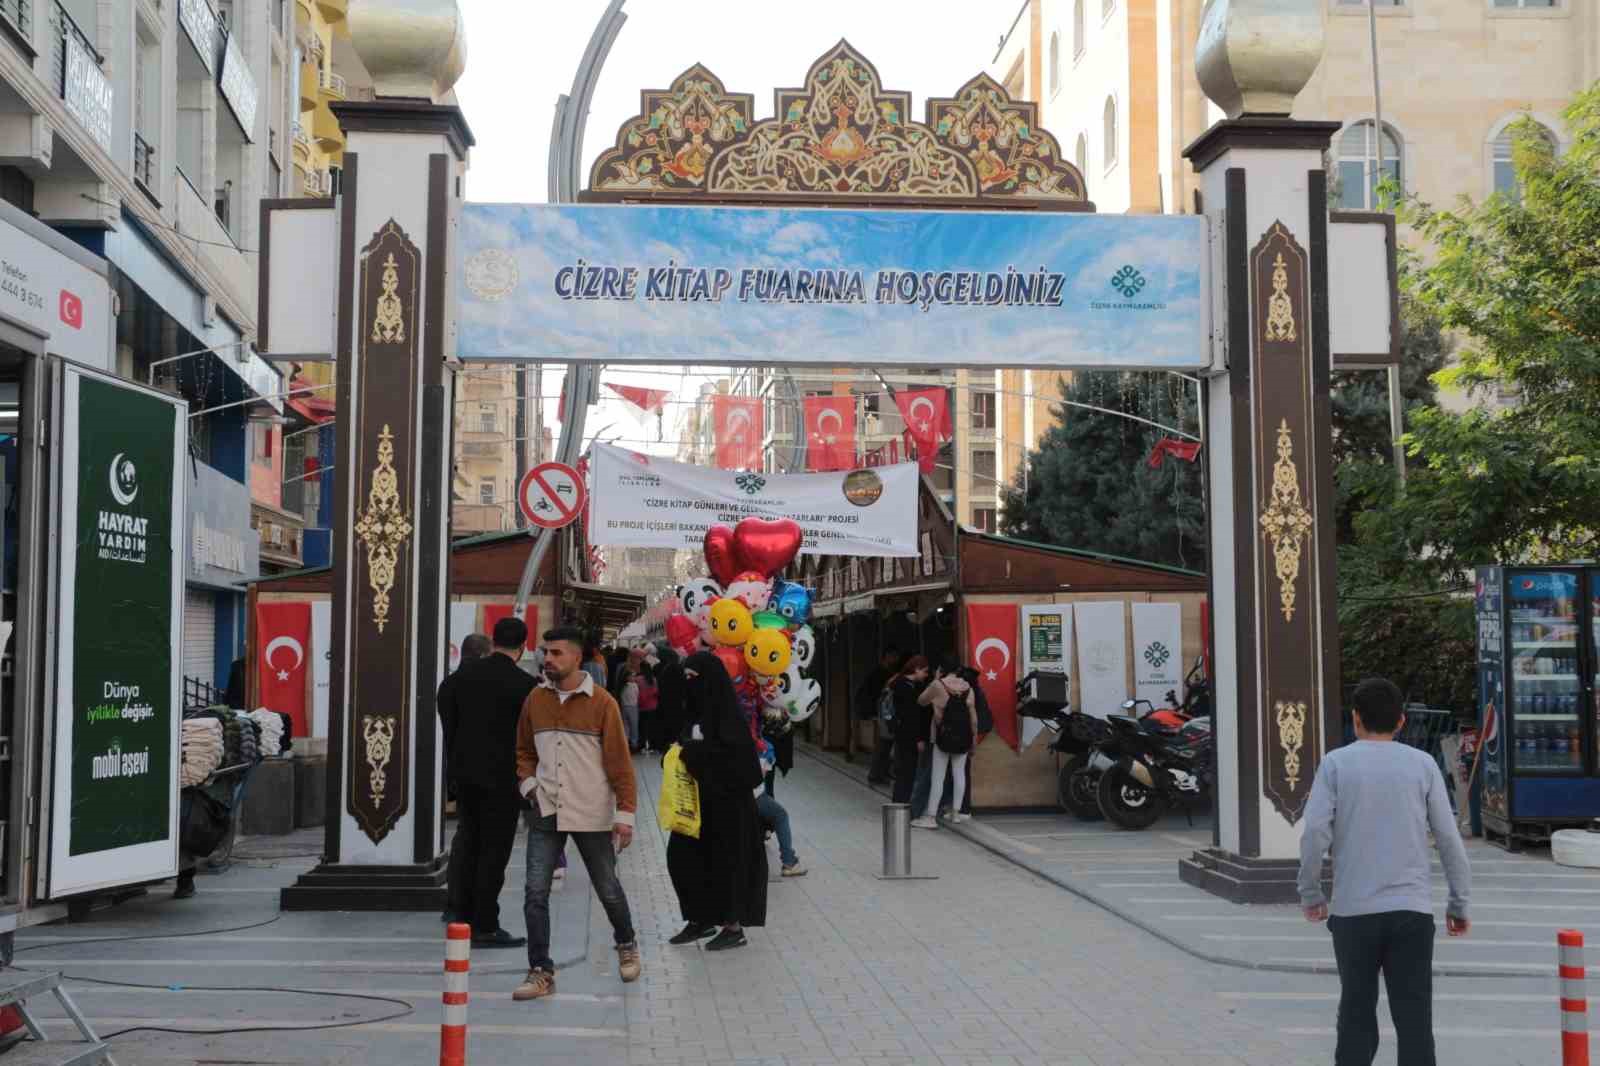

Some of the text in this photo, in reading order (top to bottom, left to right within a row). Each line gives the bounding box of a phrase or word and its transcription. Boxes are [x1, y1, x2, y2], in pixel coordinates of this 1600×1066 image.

[554, 259, 1066, 312] CİZRE KİTAP FUARINA HOŞGELDİNİZ
[670, 498, 693, 509] KİTAP
[99, 511, 148, 536] HAYRAT
[99, 532, 145, 552] YARDIM
[103, 681, 140, 702] Dünya
[87, 703, 154, 725] iyilikle değişir.
[92, 746, 148, 779] mobil aşevi
